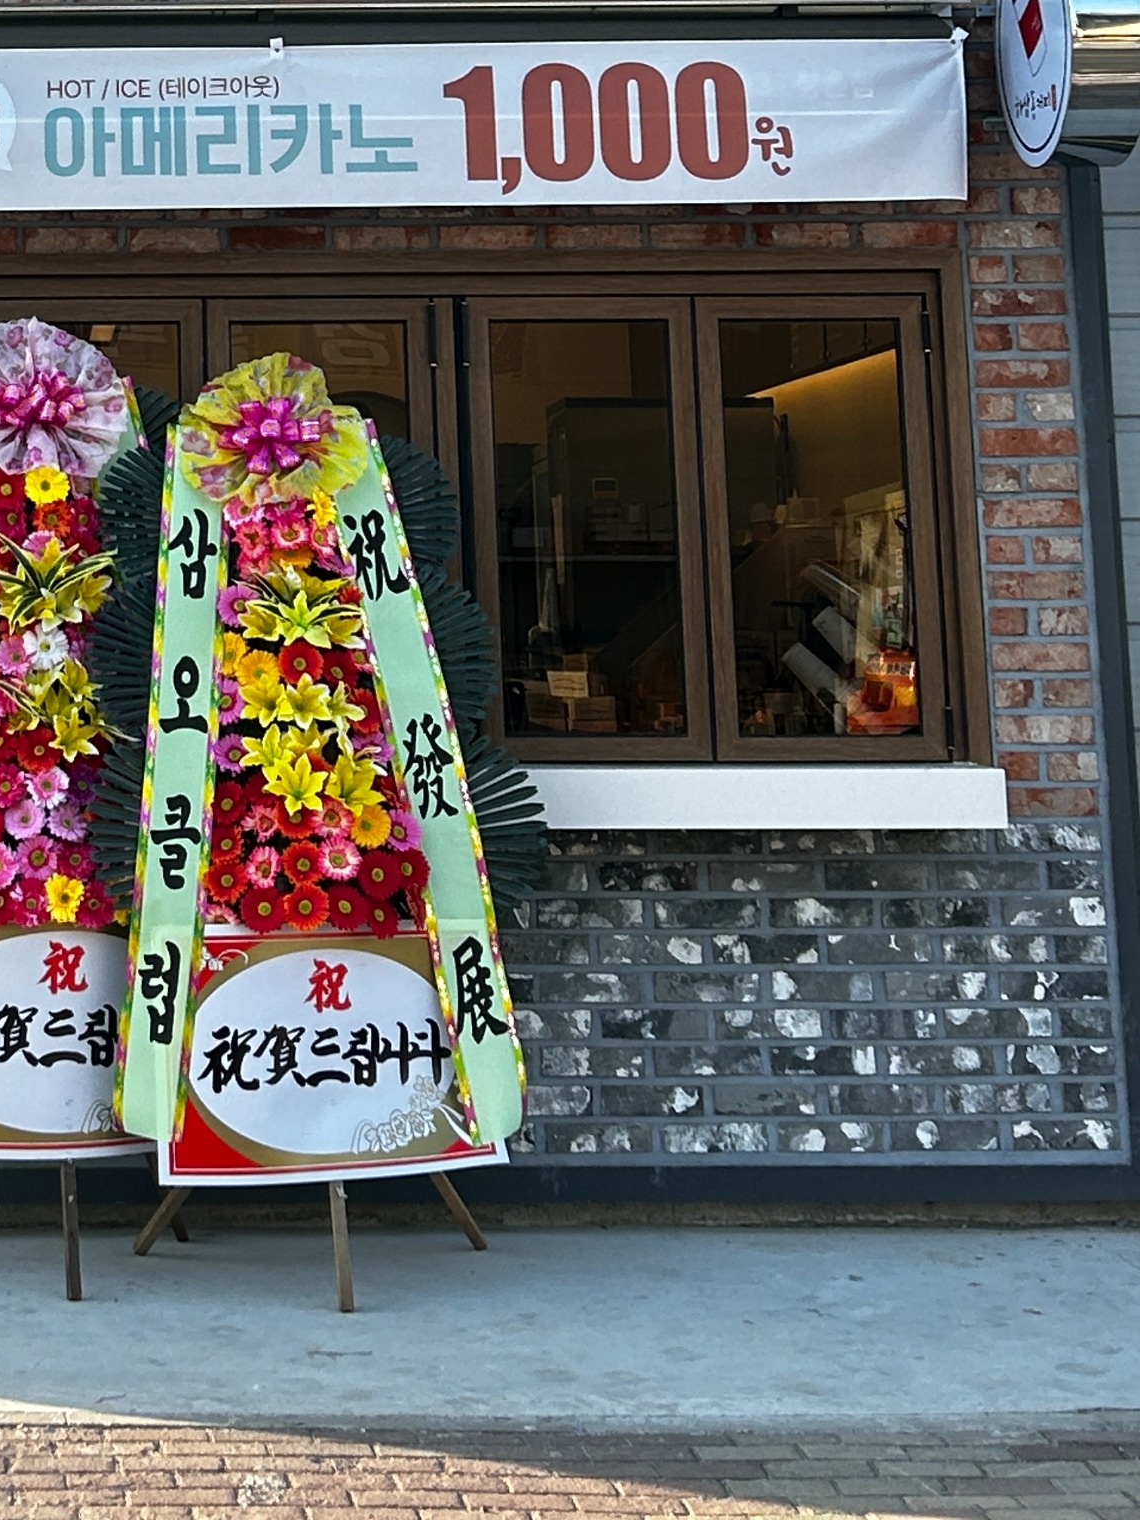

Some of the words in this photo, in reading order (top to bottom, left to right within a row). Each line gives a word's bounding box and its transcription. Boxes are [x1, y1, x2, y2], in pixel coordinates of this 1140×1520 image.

[47, 80, 95, 99] HOT
[114, 80, 152, 99] ICE
[158, 75, 280, 100] (테이크아웃)
[43, 102, 419, 177] 아메리카노
[137, 508, 219, 1046] 삼오클럽
[37, 939, 89, 995] 祝
[303, 957, 353, 1014] 祝
